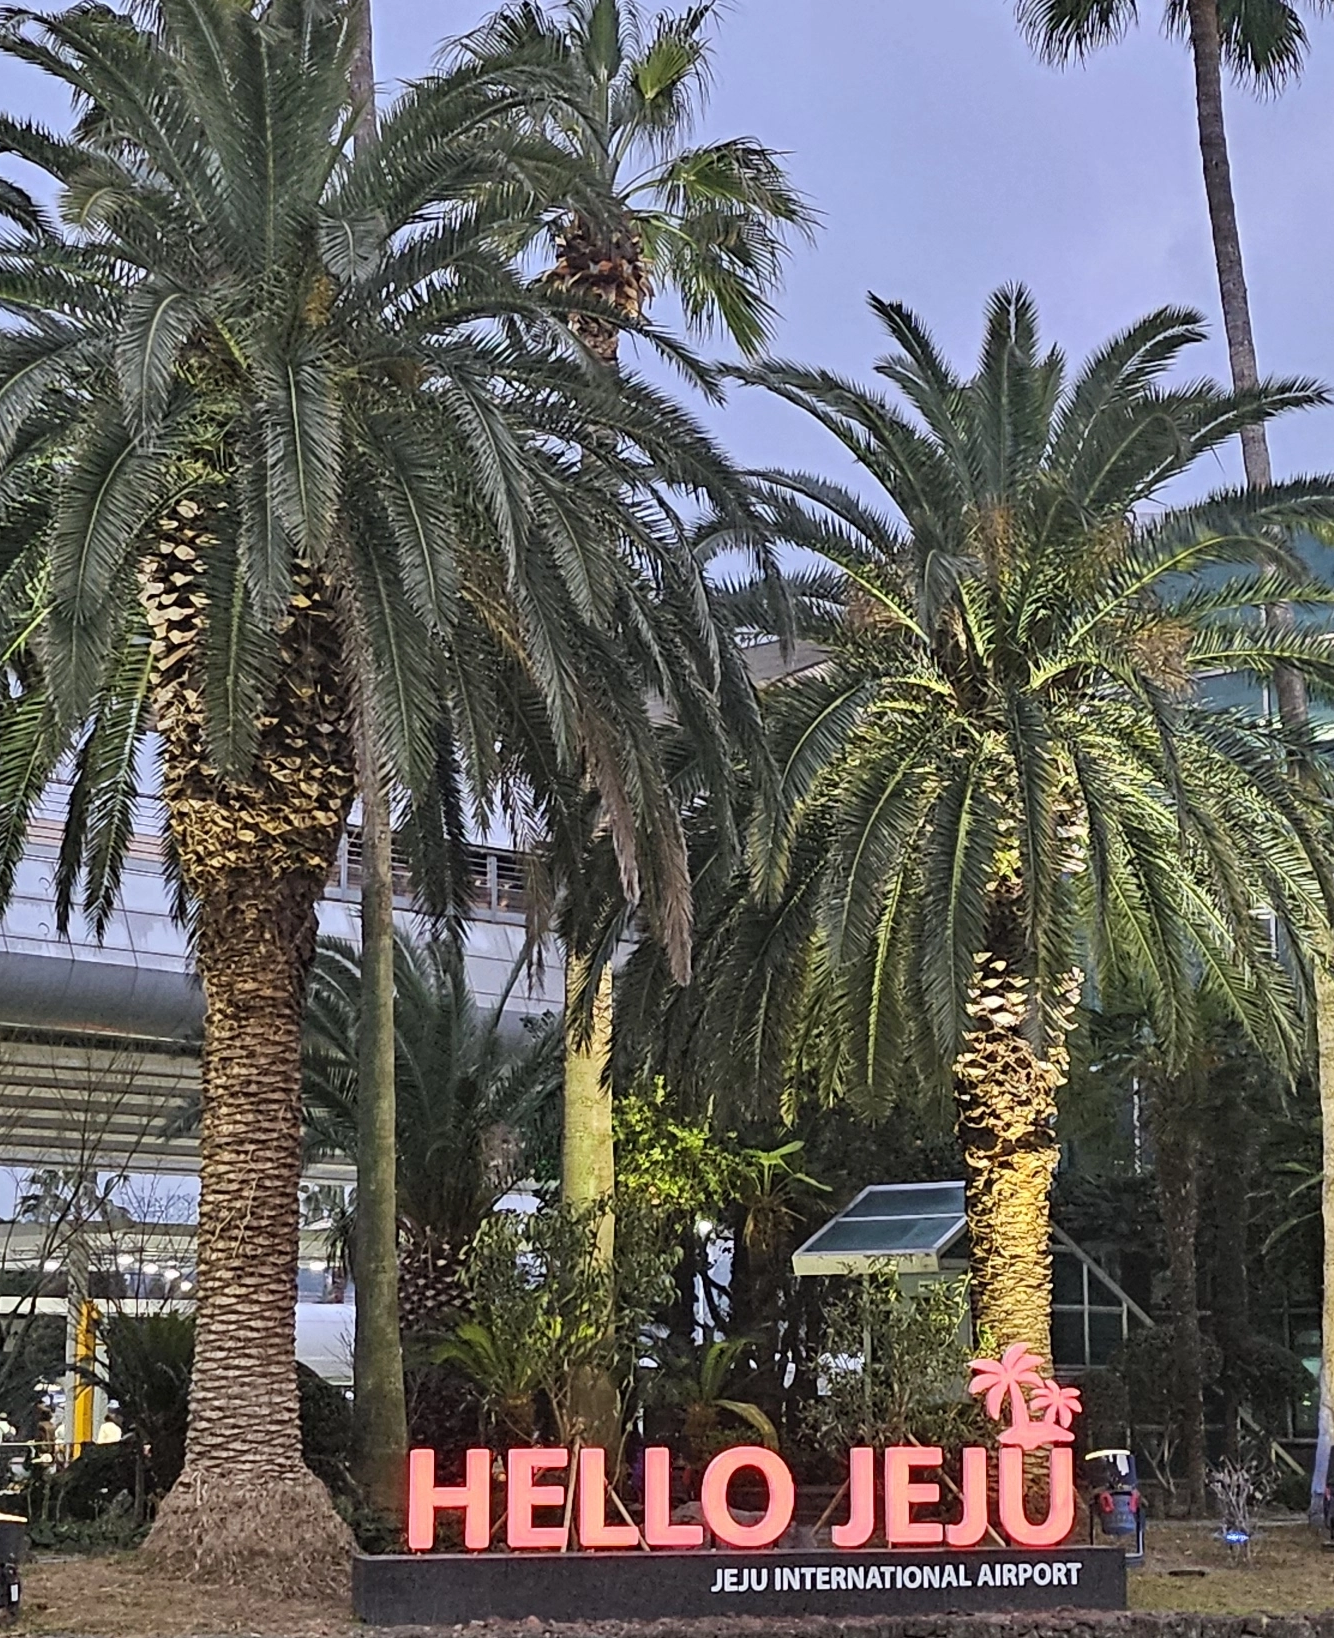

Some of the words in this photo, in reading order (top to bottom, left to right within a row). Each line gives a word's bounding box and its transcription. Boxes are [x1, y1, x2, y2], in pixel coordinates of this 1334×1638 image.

[408, 1447, 795, 1550] HELLO
[831, 1446, 1075, 1548] JEJU
[710, 1566, 768, 1594] JEJU
[774, 1565, 973, 1593] INTERNATIONAL
[979, 1563, 1083, 1589] AIRPORT
